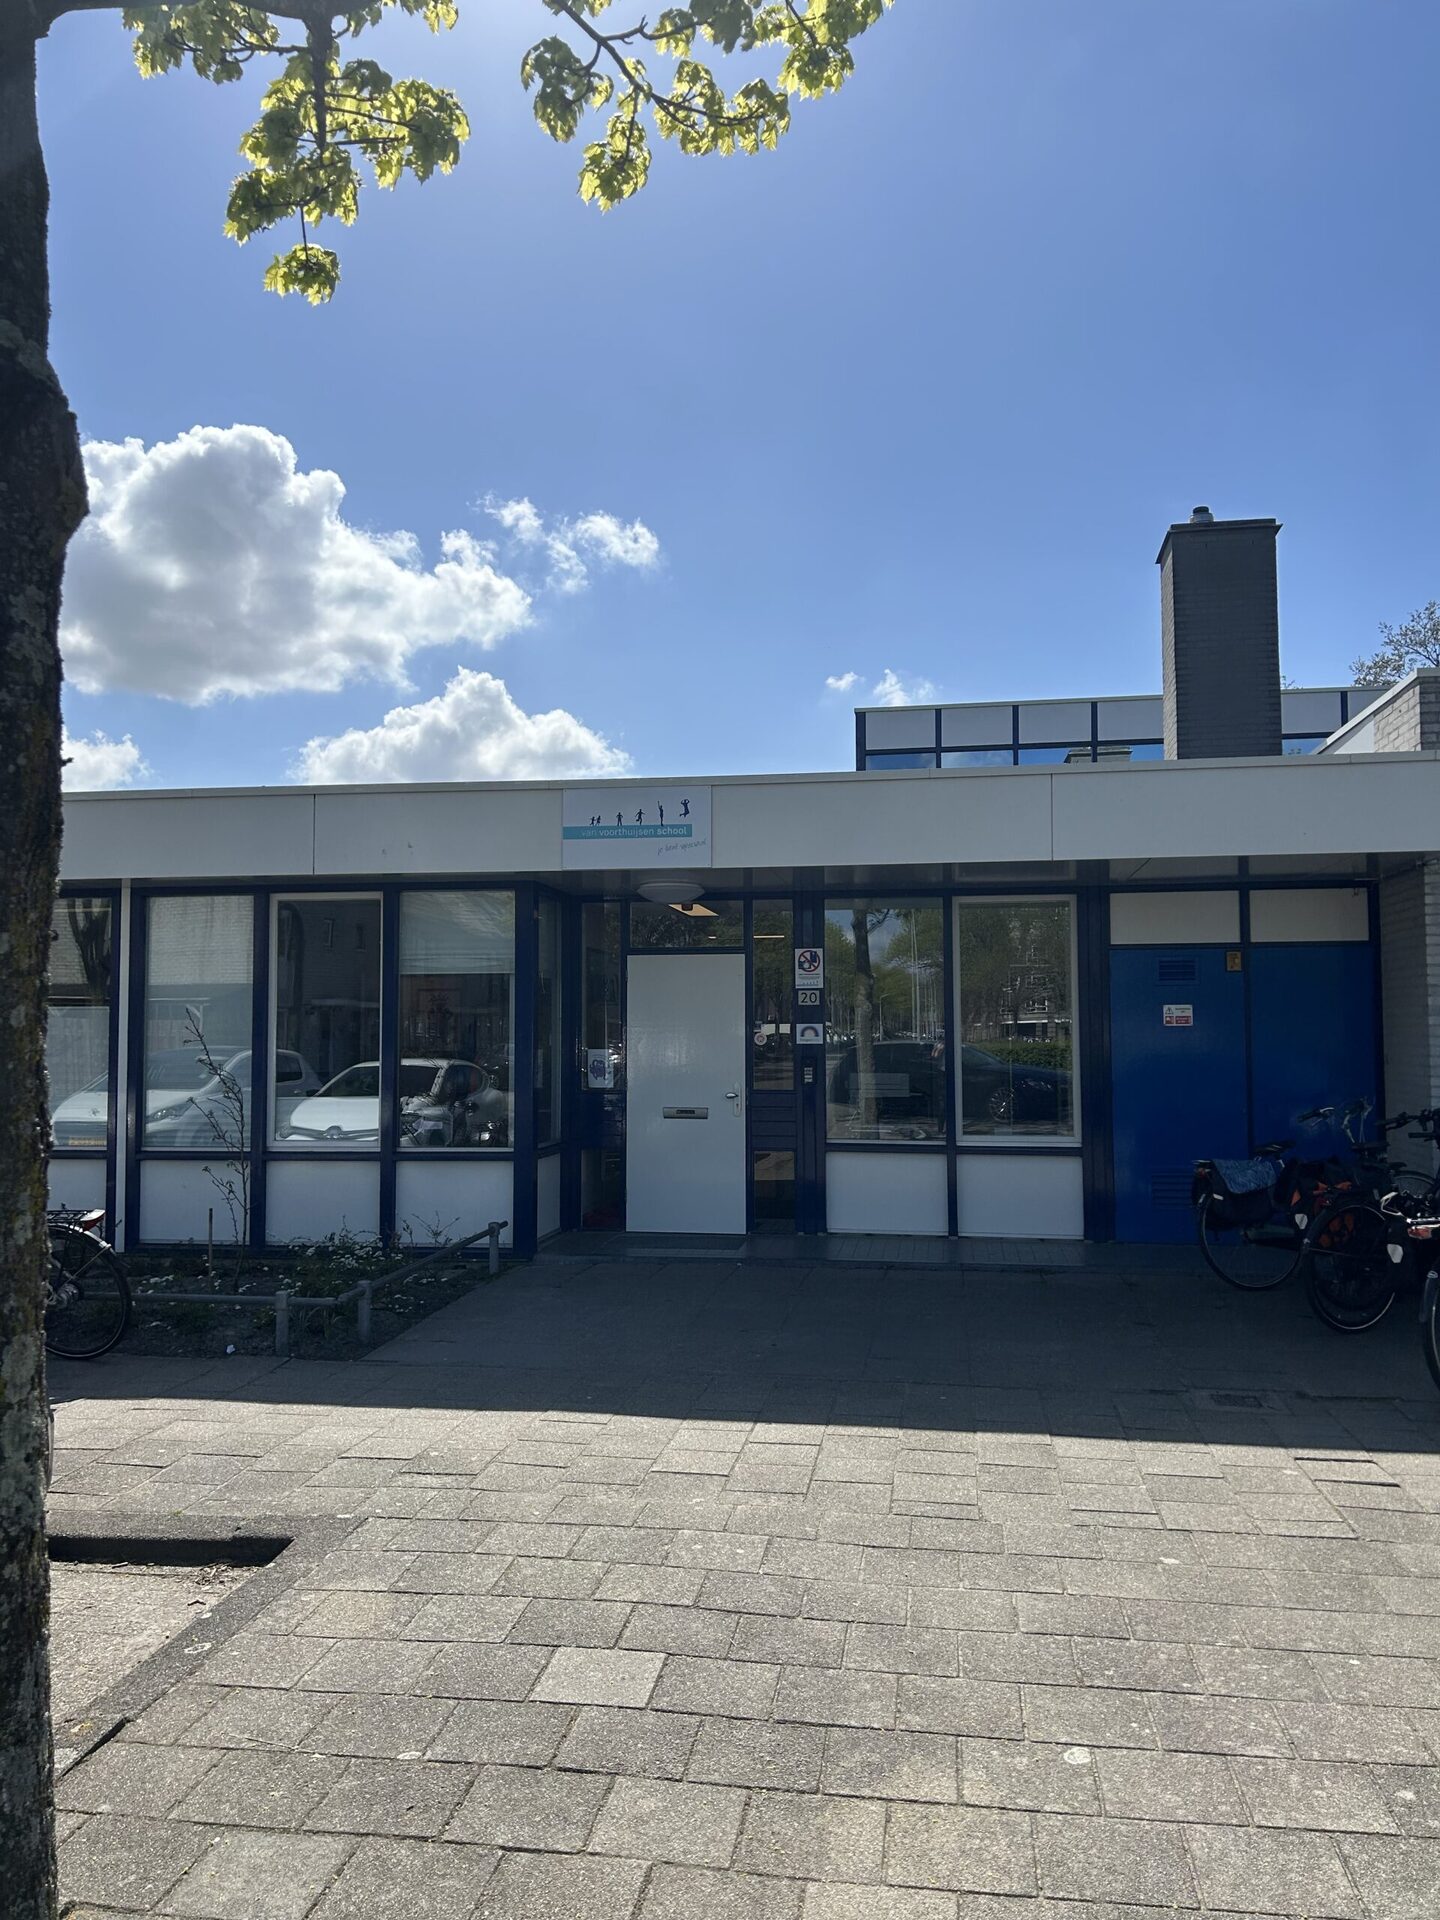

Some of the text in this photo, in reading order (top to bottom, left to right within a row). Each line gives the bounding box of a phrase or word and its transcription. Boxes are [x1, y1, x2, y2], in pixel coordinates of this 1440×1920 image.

[581, 826, 687, 838] van voorthuijsen school
[800, 992, 818, 1004] 20
